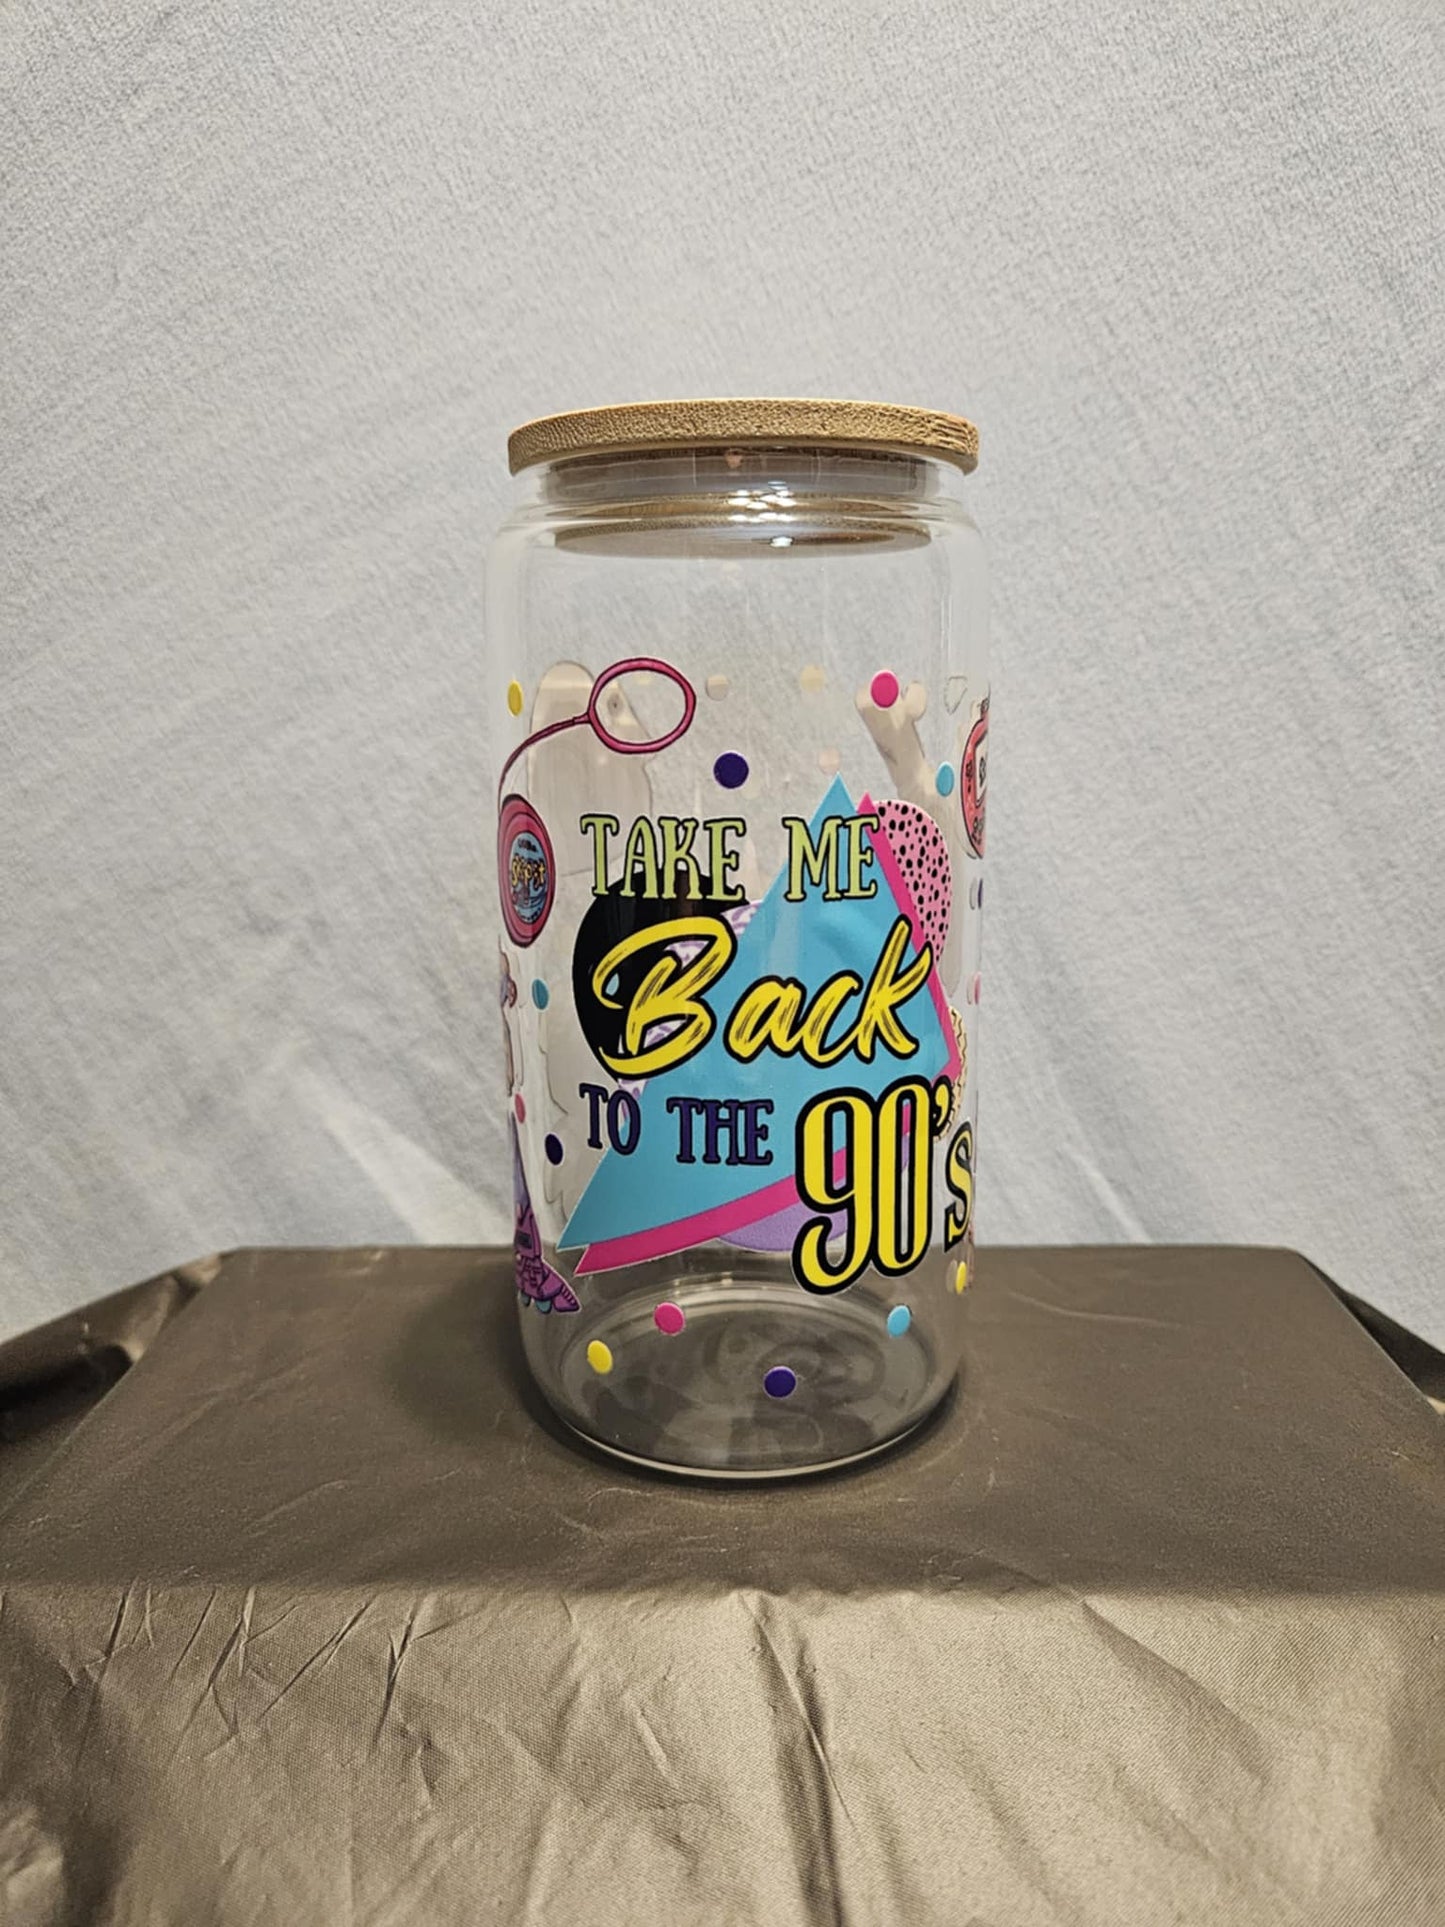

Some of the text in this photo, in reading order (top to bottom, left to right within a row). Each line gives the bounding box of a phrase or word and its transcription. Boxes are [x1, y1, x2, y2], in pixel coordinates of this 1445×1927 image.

[580, 813, 879, 902] TAKE ME
[591, 914, 932, 1079] Back
[579, 1083, 641, 1155] TO
[666, 1097, 774, 1165] THE
